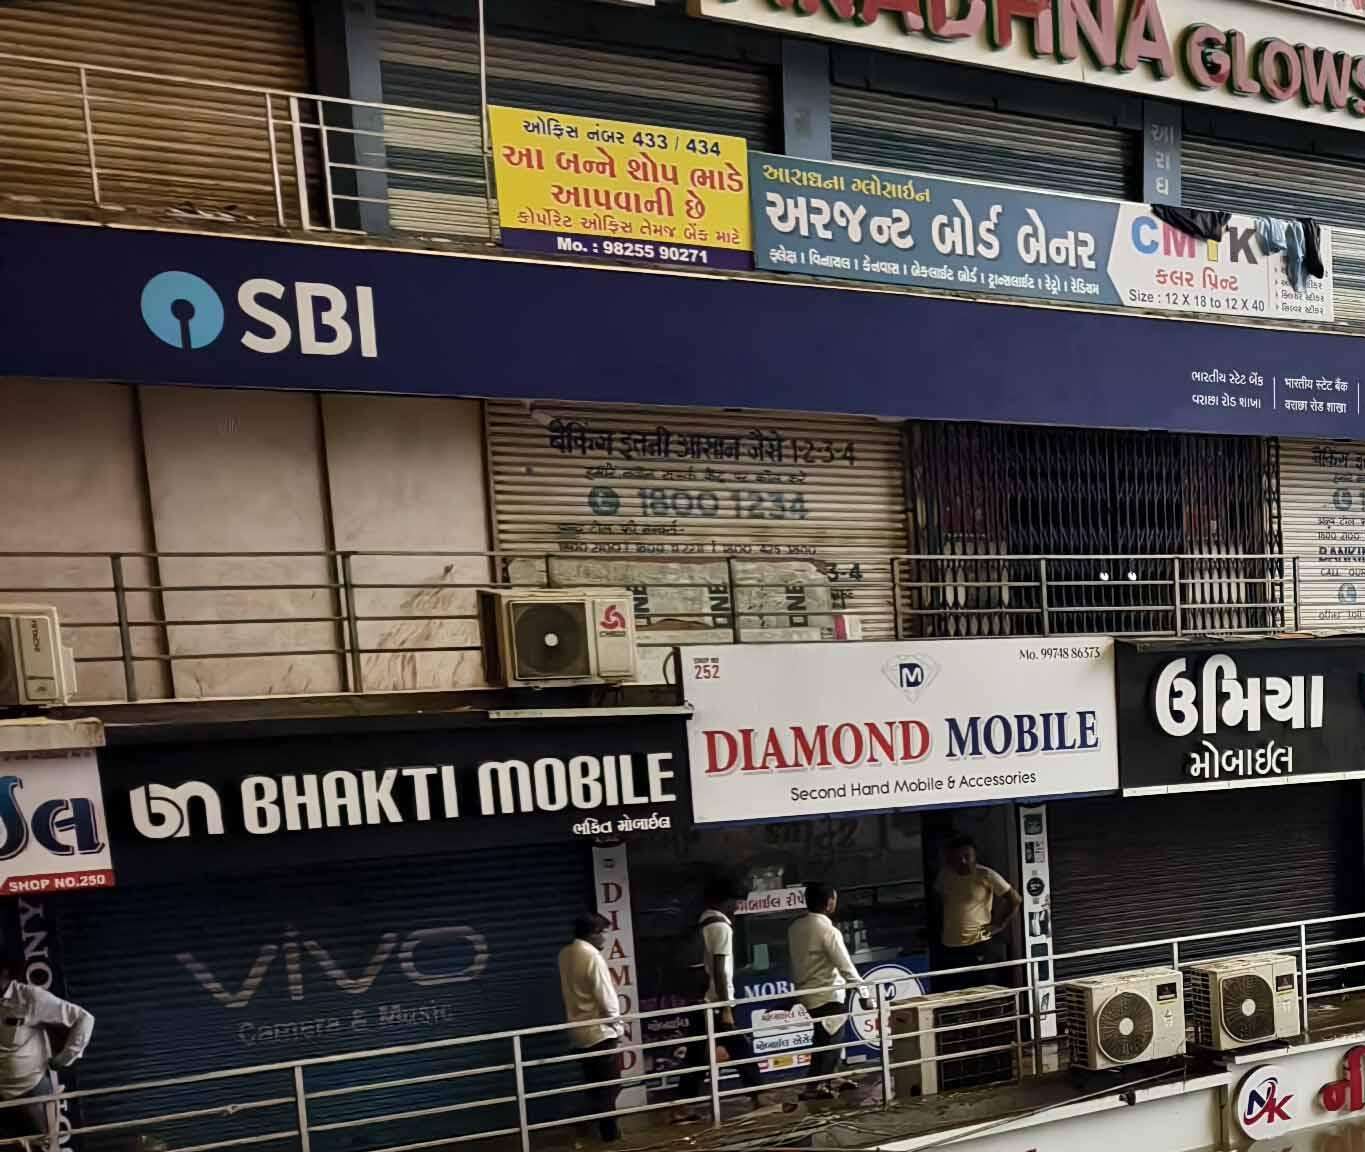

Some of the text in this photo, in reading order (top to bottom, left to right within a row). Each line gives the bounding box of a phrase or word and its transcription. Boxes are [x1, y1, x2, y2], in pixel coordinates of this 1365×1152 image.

[523, 117, 720, 156] ઓફિસ નંબર 433 434
[503, 145, 744, 193] આ બન્ને શોપ ભાડે
[762, 163, 845, 192] આરાધના
[551, 183, 706, 220] આપવાની છે
[580, 214, 633, 234] ઓફિસ
[640, 219, 676, 237] તેમજ
[715, 228, 741, 245] માટે
[765, 190, 1097, 270] અરજન્ટ બોર્ડ બેનર
[557, 237, 708, 263] Mo. 98255 90271
[1155, 266, 1239, 292] કલર પ્રિન્ટ
[1129, 288, 1265, 311] Size 12 18 to 12 40
[237, 278, 378, 358] SBI
[1191, 368, 1246, 385] ભારતીય સ્ટેટ
[1285, 375, 1333, 391] भारतीय स्टेट
[1192, 393, 1261, 409] વરાછા રોડ શાખા
[1285, 397, 1347, 414] वराछा रोड शाखा
[1041, 646, 1101, 660] 99748 86373
[694, 664, 720, 680] 252
[1154, 653, 1325, 738] ઉમિયા
[703, 710, 1100, 774] DIAMOND MOBILE
[1190, 741, 1294, 779] મોબાઈલ
[241, 752, 676, 834] BHAKTI MOBILE
[791, 770, 1037, 802] Second Hand Mobile Accessories
[617, 812, 672, 833] મોબાઈલ
[9, 873, 107, 893] SHOP NO.250
[177, 922, 489, 1009] vivo
